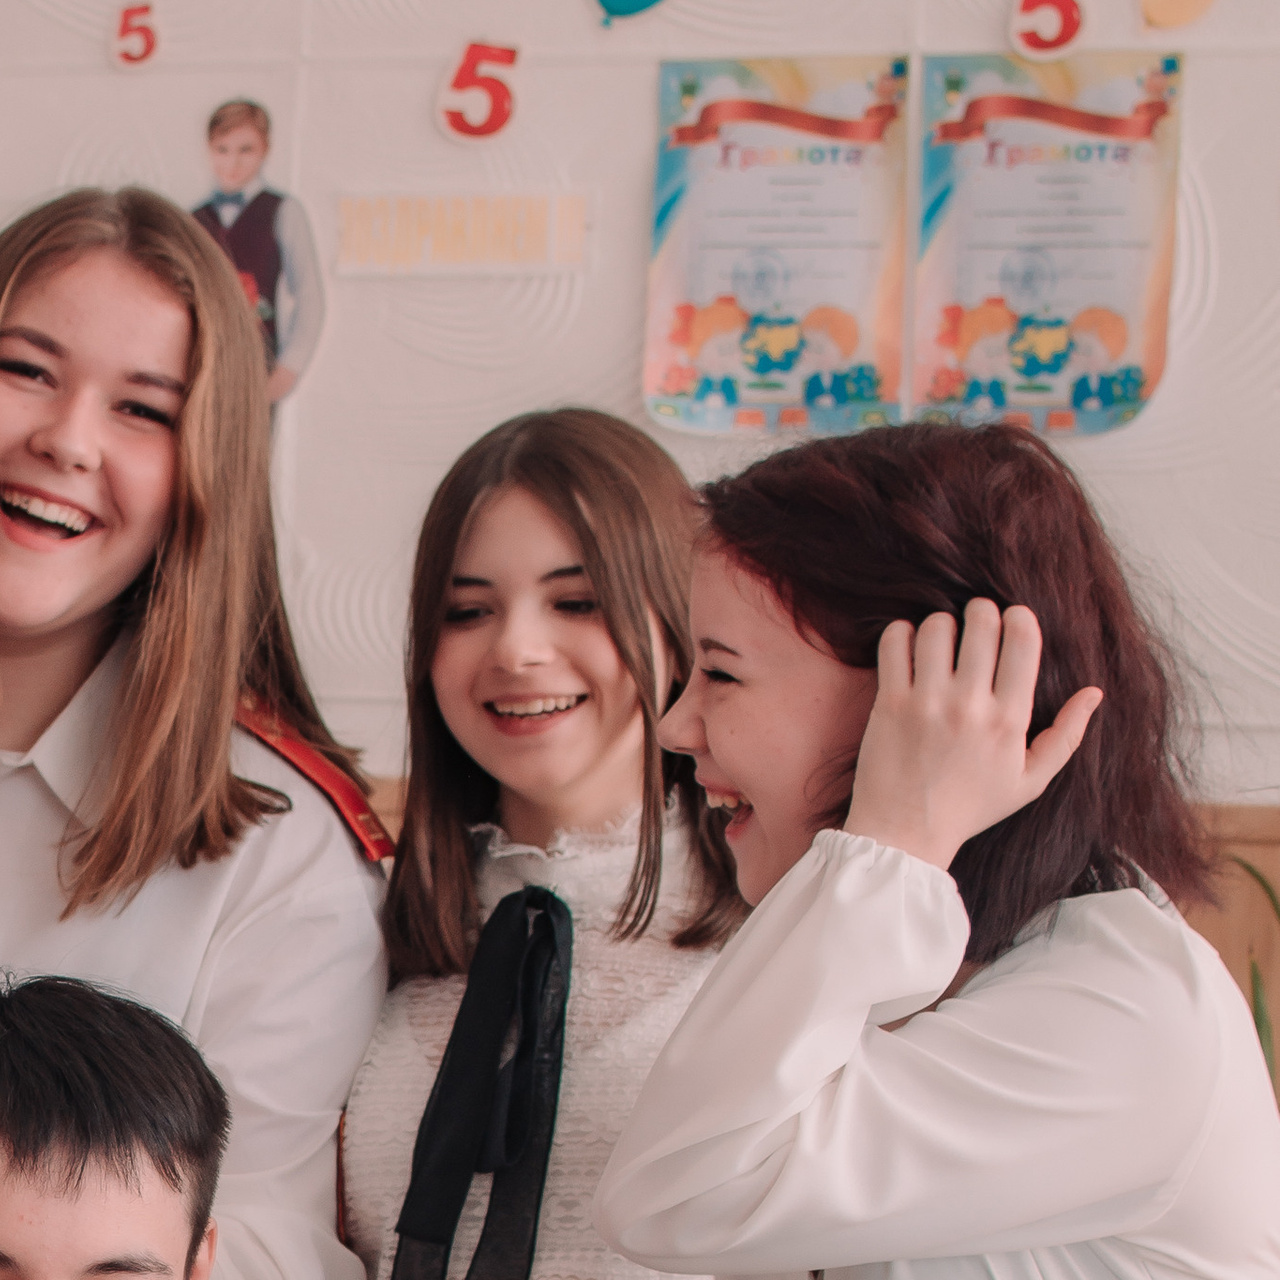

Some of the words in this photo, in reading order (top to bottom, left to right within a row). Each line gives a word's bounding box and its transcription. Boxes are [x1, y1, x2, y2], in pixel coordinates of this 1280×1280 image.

[119, 5, 157, 64] 5
[1019, 0, 1082, 51] 5
[443, 43, 518, 138] 5
